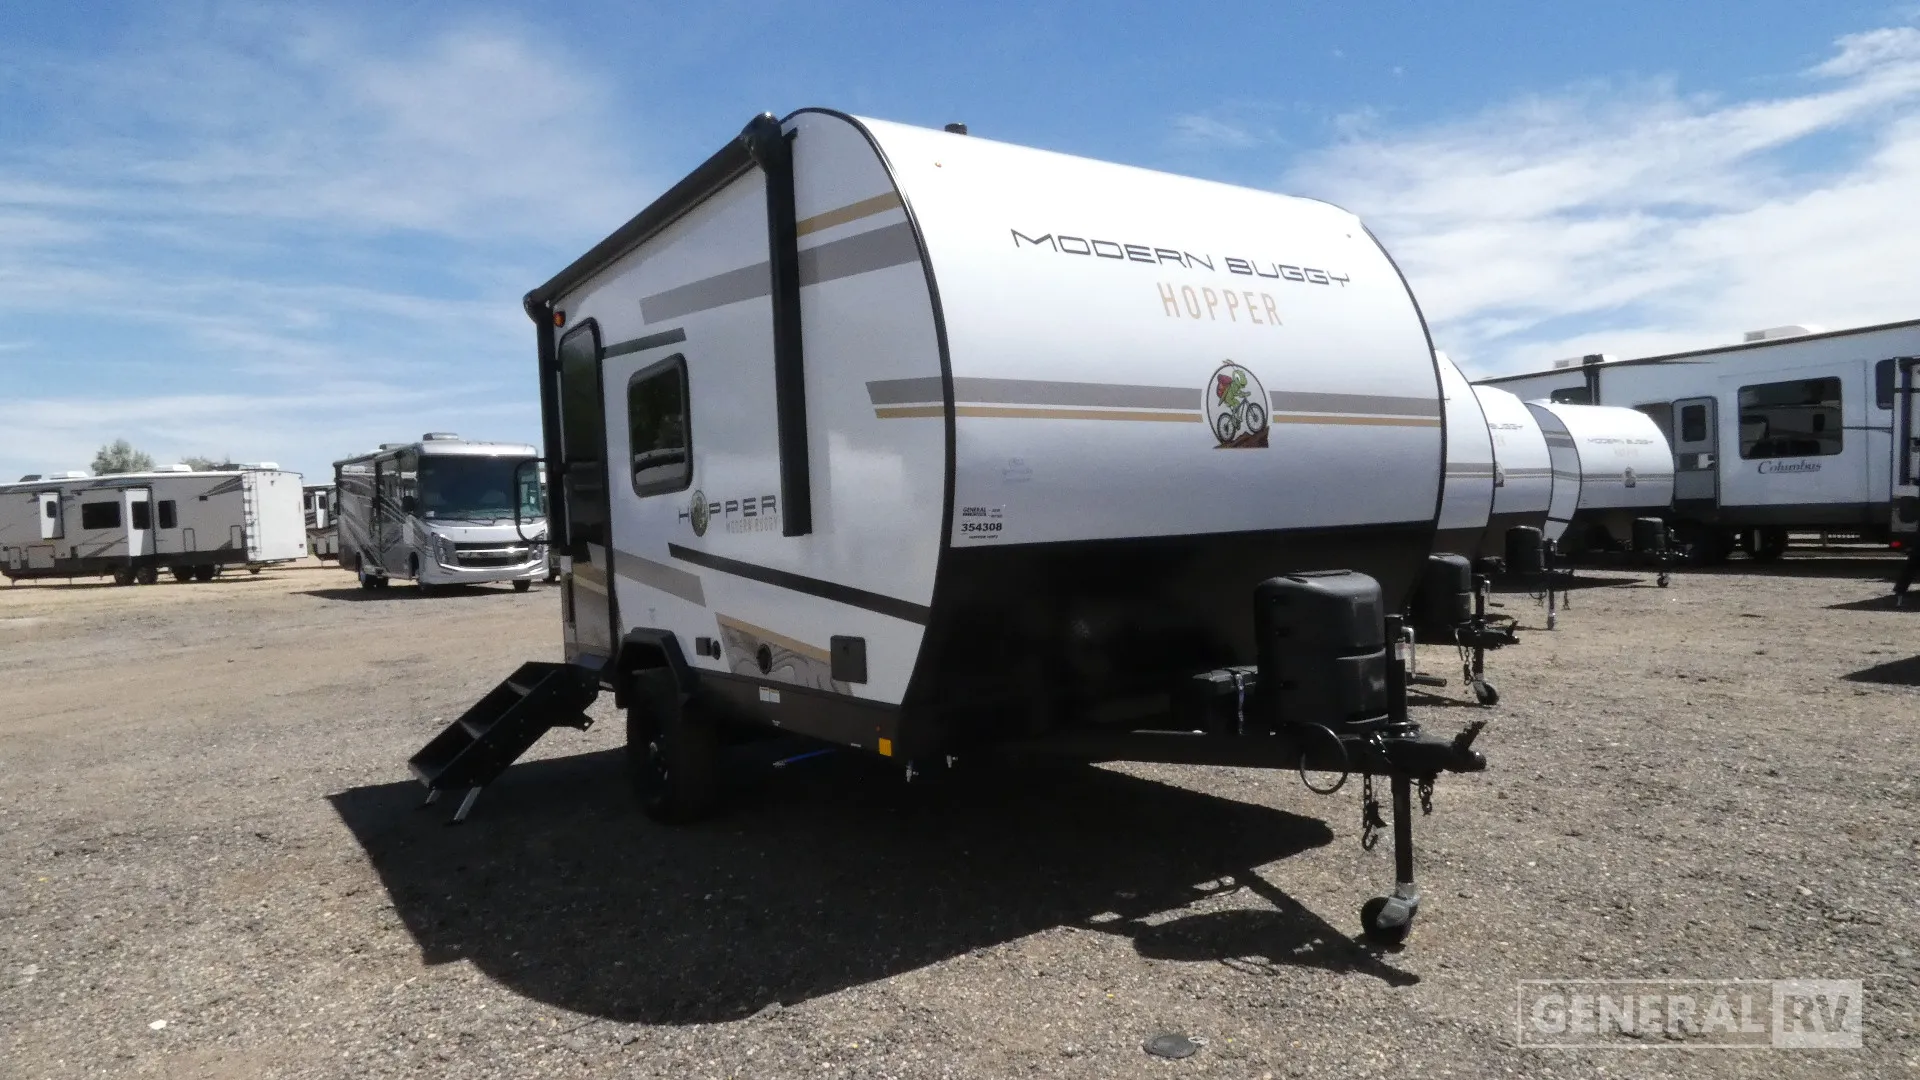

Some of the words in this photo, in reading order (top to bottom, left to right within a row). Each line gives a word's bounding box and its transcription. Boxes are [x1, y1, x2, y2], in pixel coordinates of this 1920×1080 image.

[1010, 228, 1215, 271] MODERN
[1225, 256, 1350, 287] BUGGY
[1156, 281, 1284, 326] HOPPER
[1757, 459, 1822, 475] Columbus
[960, 522, 1003, 532] 354308
